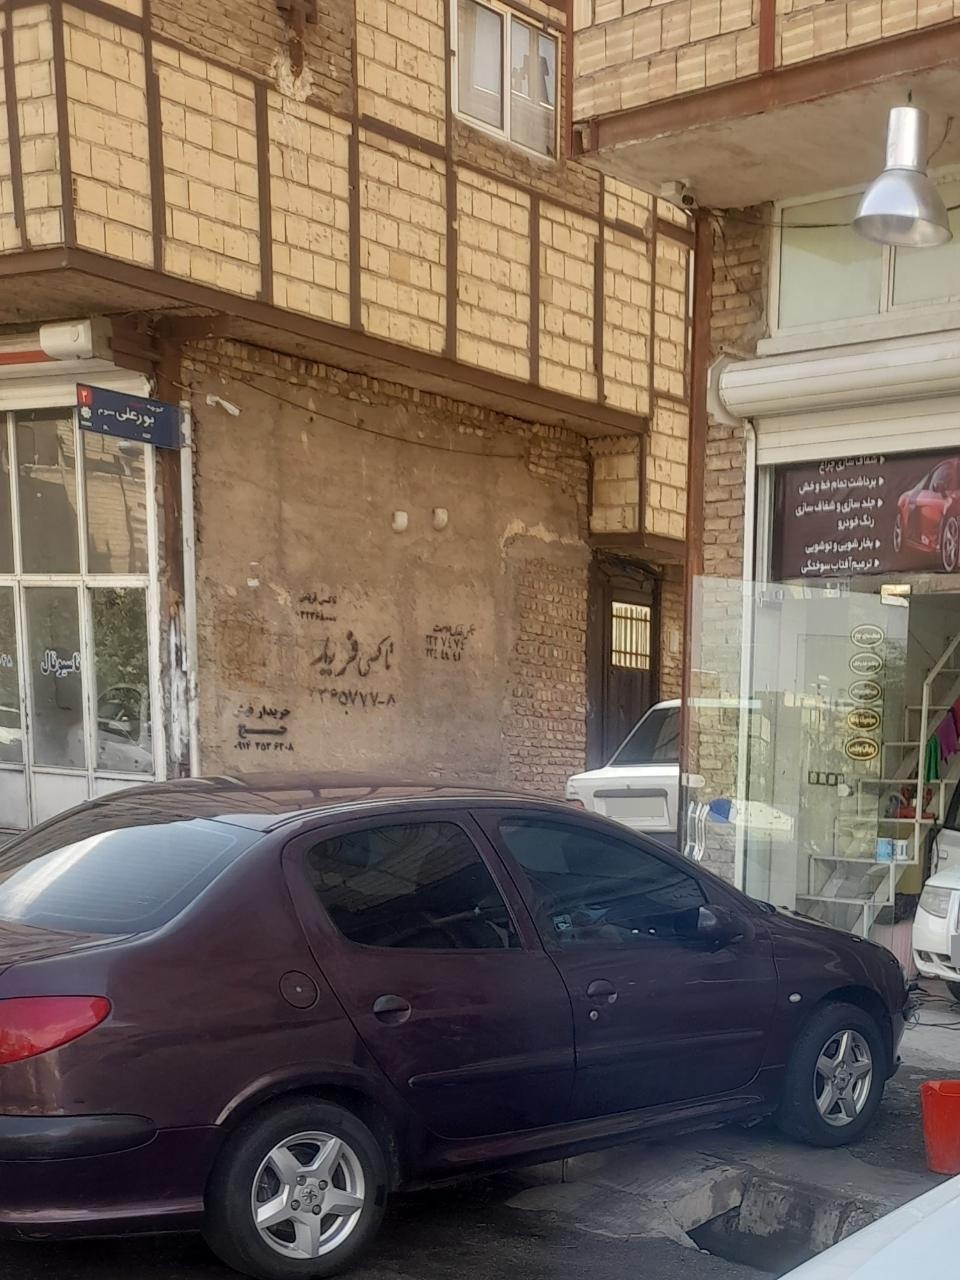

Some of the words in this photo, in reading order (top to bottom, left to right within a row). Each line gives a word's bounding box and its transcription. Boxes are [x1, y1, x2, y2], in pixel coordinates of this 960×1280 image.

[799, 480, 814, 494] خش
[831, 479, 847, 492] تمام
[847, 476, 877, 488] برداشت
[838, 516, 859, 530] خودرو
[860, 514, 875, 527] رنگ
